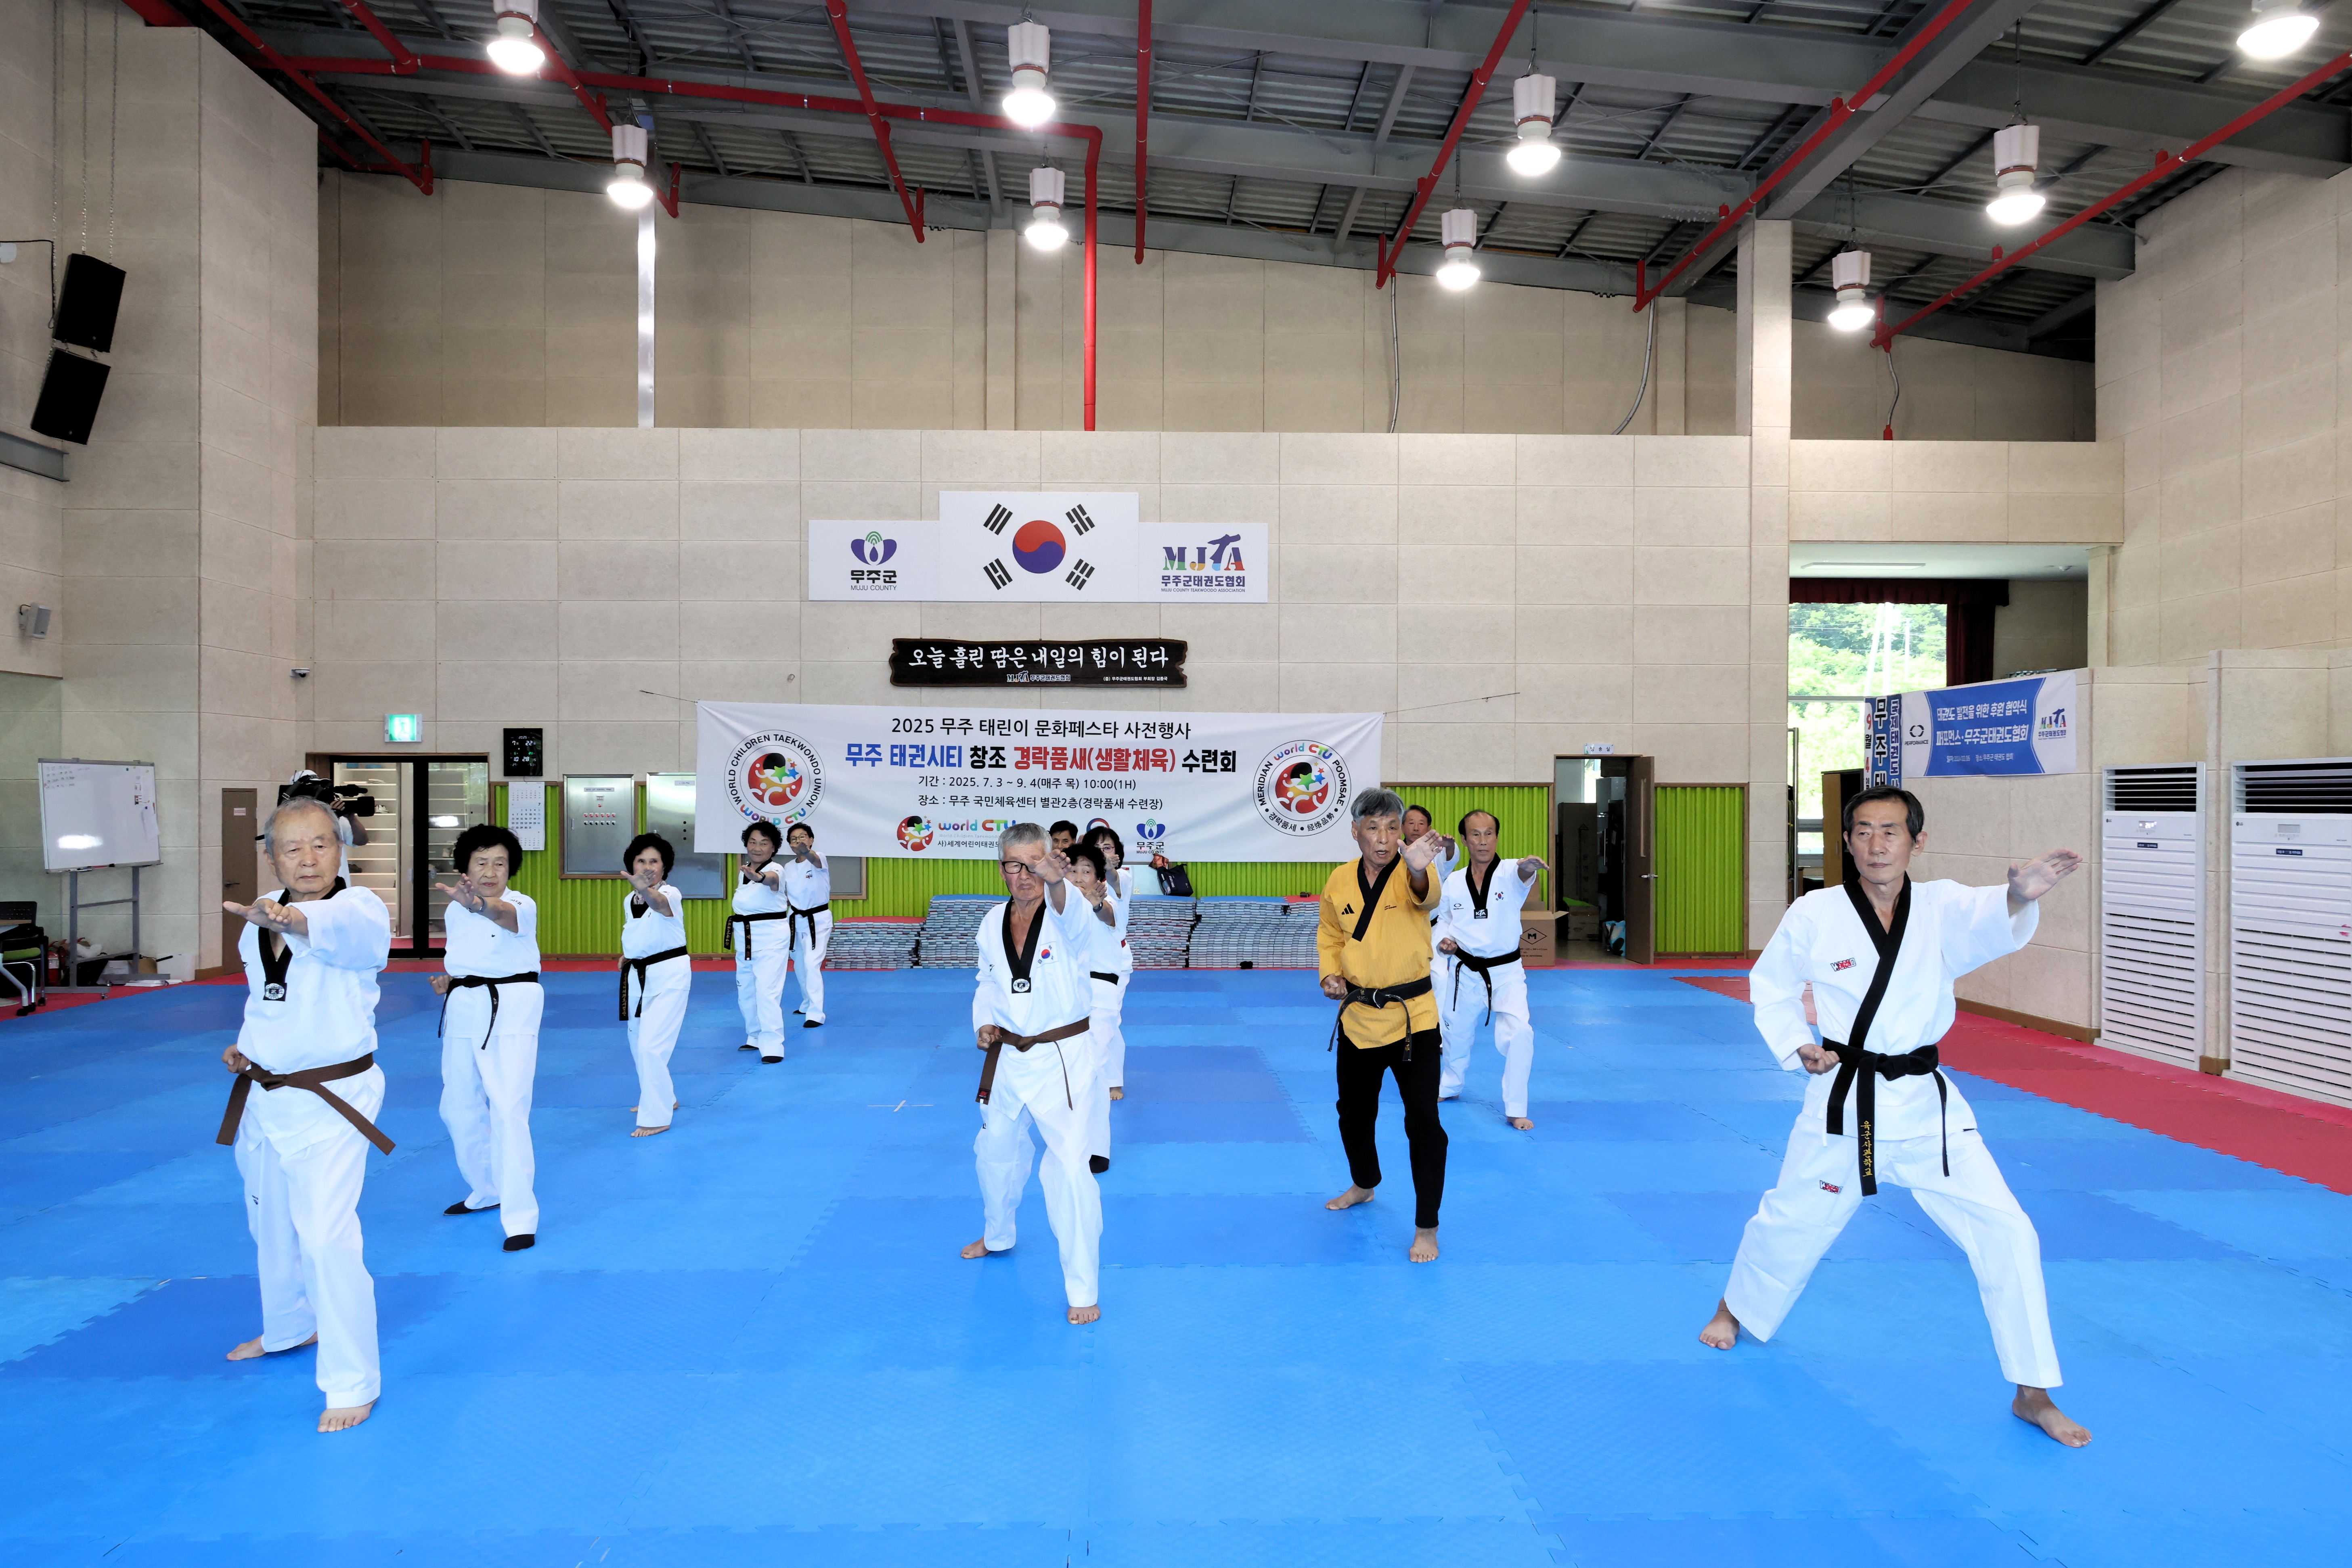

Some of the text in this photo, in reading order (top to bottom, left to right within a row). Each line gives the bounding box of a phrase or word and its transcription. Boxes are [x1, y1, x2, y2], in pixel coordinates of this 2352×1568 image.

[851, 570, 897, 584] 무주군
[1161, 575, 1245, 587] 무주군태권도협회
[909, 647, 1169, 669] 오늘 흘린 땀은 내일의 힘이 된다
[1937, 699, 2027, 721] 태권도 발전을 위한 후원 협약식
[892, 718, 1191, 739] 2025 무주 태린이 문화페스타 사전행사
[1890, 699, 1900, 775] 국제태권도
[846, 743, 1236, 772] 무주 태권시티 창조 경락품새(생활체육) 수련회
[1273, 743, 1333, 761] world CTU
[728, 734, 821, 808] WORLD CHILDREN TAEKWONDO UNION
[918, 776, 939, 787] 기간
[949, 777, 979, 787] 2025.
[983, 778, 993, 787] 7.
[996, 778, 1003, 787] 3
[1017, 778, 1027, 788] 9.
[1030, 778, 1062, 789] 4(매주
[1065, 778, 1079, 789] 목)
[1084, 779, 1136, 790] 10:00(1H)
[1257, 761, 1273, 806] MERIDIAN
[1332, 759, 1347, 806] POOMSAE
[918, 795, 939, 805] 장소
[949, 796, 970, 806] 무주
[973, 796, 1037, 808] 국민체육센터
[1040, 797, 1125, 810] 별관2층(경락품새
[1128, 798, 1163, 810] 수련장)
[785, 808, 806, 824] CTU
[938, 819, 977, 831] world
[1269, 812, 1297, 832] 경락품세
[1136, 842, 1165, 850] 무주군
[1860, 1120, 1873, 1177] 육군사관학교
